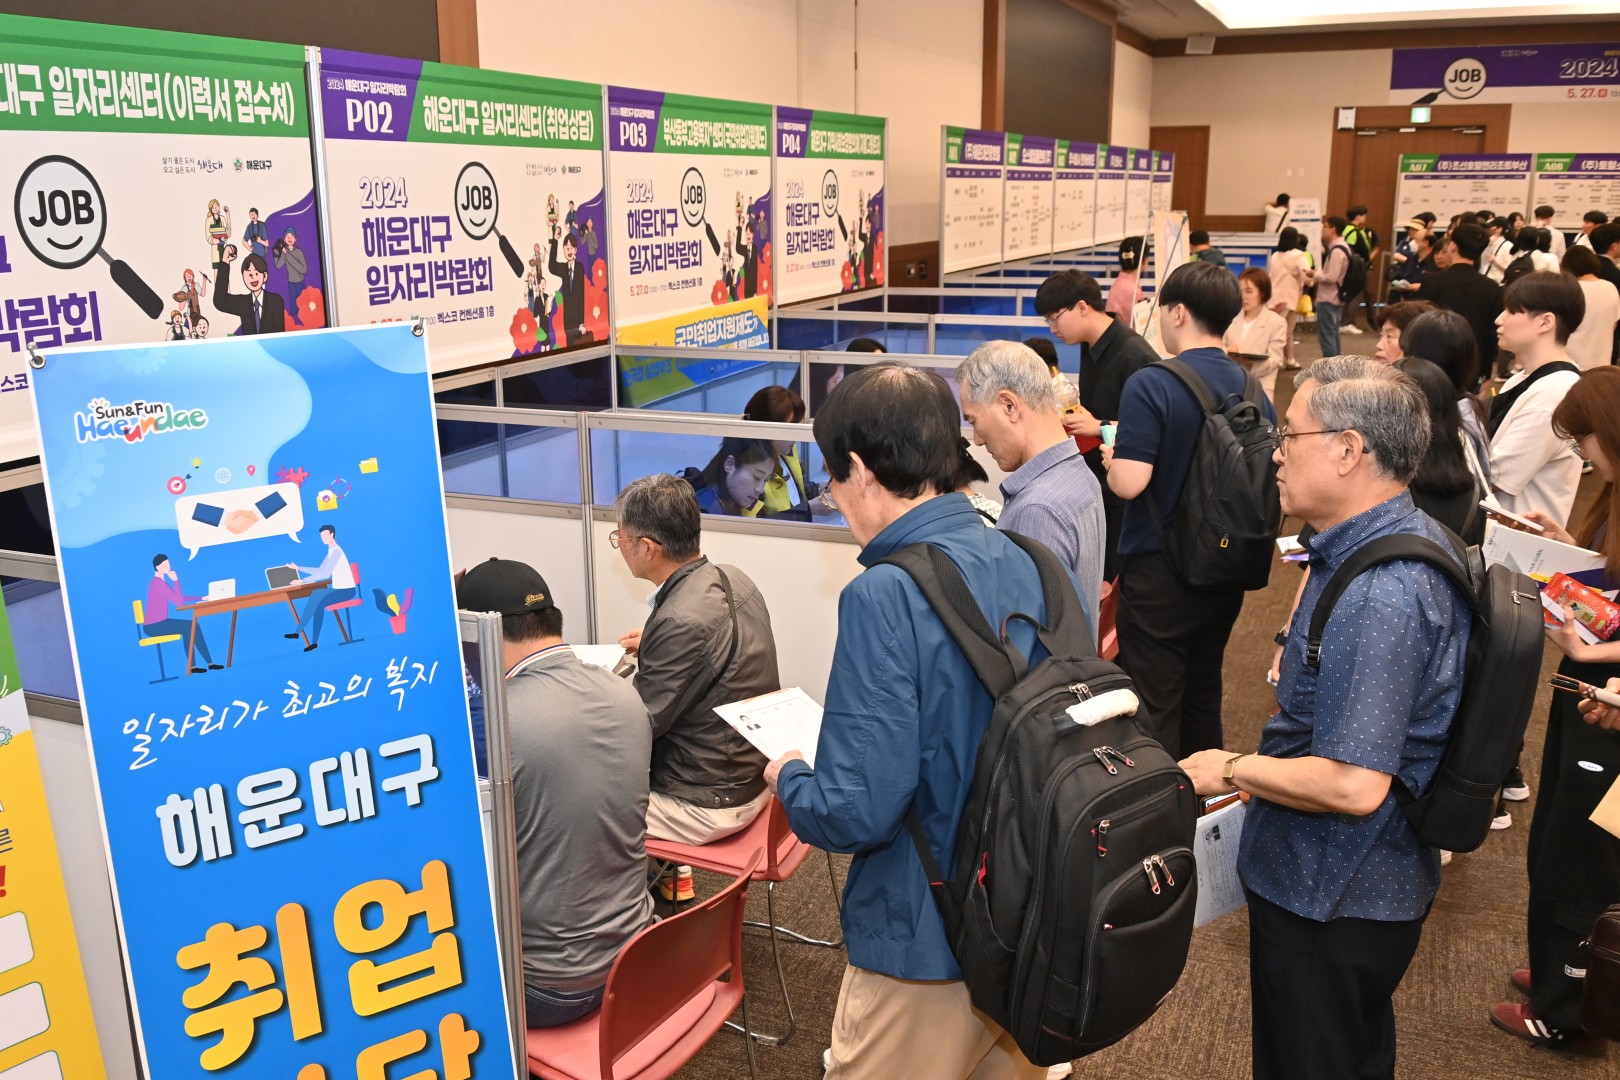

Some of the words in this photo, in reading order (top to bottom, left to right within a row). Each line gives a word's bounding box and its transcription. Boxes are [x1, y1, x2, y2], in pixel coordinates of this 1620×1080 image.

[1449, 68, 1482, 83] JOB
[1560, 58, 1619, 79] 2024
[48, 66, 233, 122] 일자리센터(이력서
[233, 79, 295, 126] 접수처)
[327, 77, 344, 91] 2024
[345, 78, 370, 93] 해운대구
[370, 80, 407, 97] 일자리박람회
[346, 98, 394, 134] P02
[423, 95, 479, 135] 해운대구
[481, 101, 593, 142] 일자리센터(취업상담)
[620, 121, 647, 147] P03
[782, 133, 801, 154] P04
[246, 160, 272, 170] 해운대구
[359, 176, 408, 208] 2024
[461, 185, 492, 211] JOB
[626, 178, 654, 203] 2024
[684, 185, 703, 204] JOB
[786, 179, 804, 199] 2024
[824, 184, 837, 199] JOB
[29, 189, 95, 227] JOB
[786, 202, 820, 227] 해운대구
[362, 215, 453, 257] 해운대구
[627, 208, 678, 239] 해운대구
[786, 228, 835, 256] 일자리박람회
[629, 240, 703, 275] 일자리박람회
[366, 256, 493, 306] 일자리박람회
[437, 312, 458, 324] 벡스코
[459, 307, 485, 321] 컨벤션홀
[486, 305, 495, 318] 1층
[675, 311, 758, 347] 국민취업지원제도가
[77, 405, 206, 442] Haeundae
[95, 401, 163, 419] Sun&Fun
[122, 700, 269, 770] 일자리가
[282, 673, 373, 719] 최고의
[385, 656, 439, 712] 복지
[155, 733, 440, 868] 해운대구
[176, 859, 464, 1071] 취업
